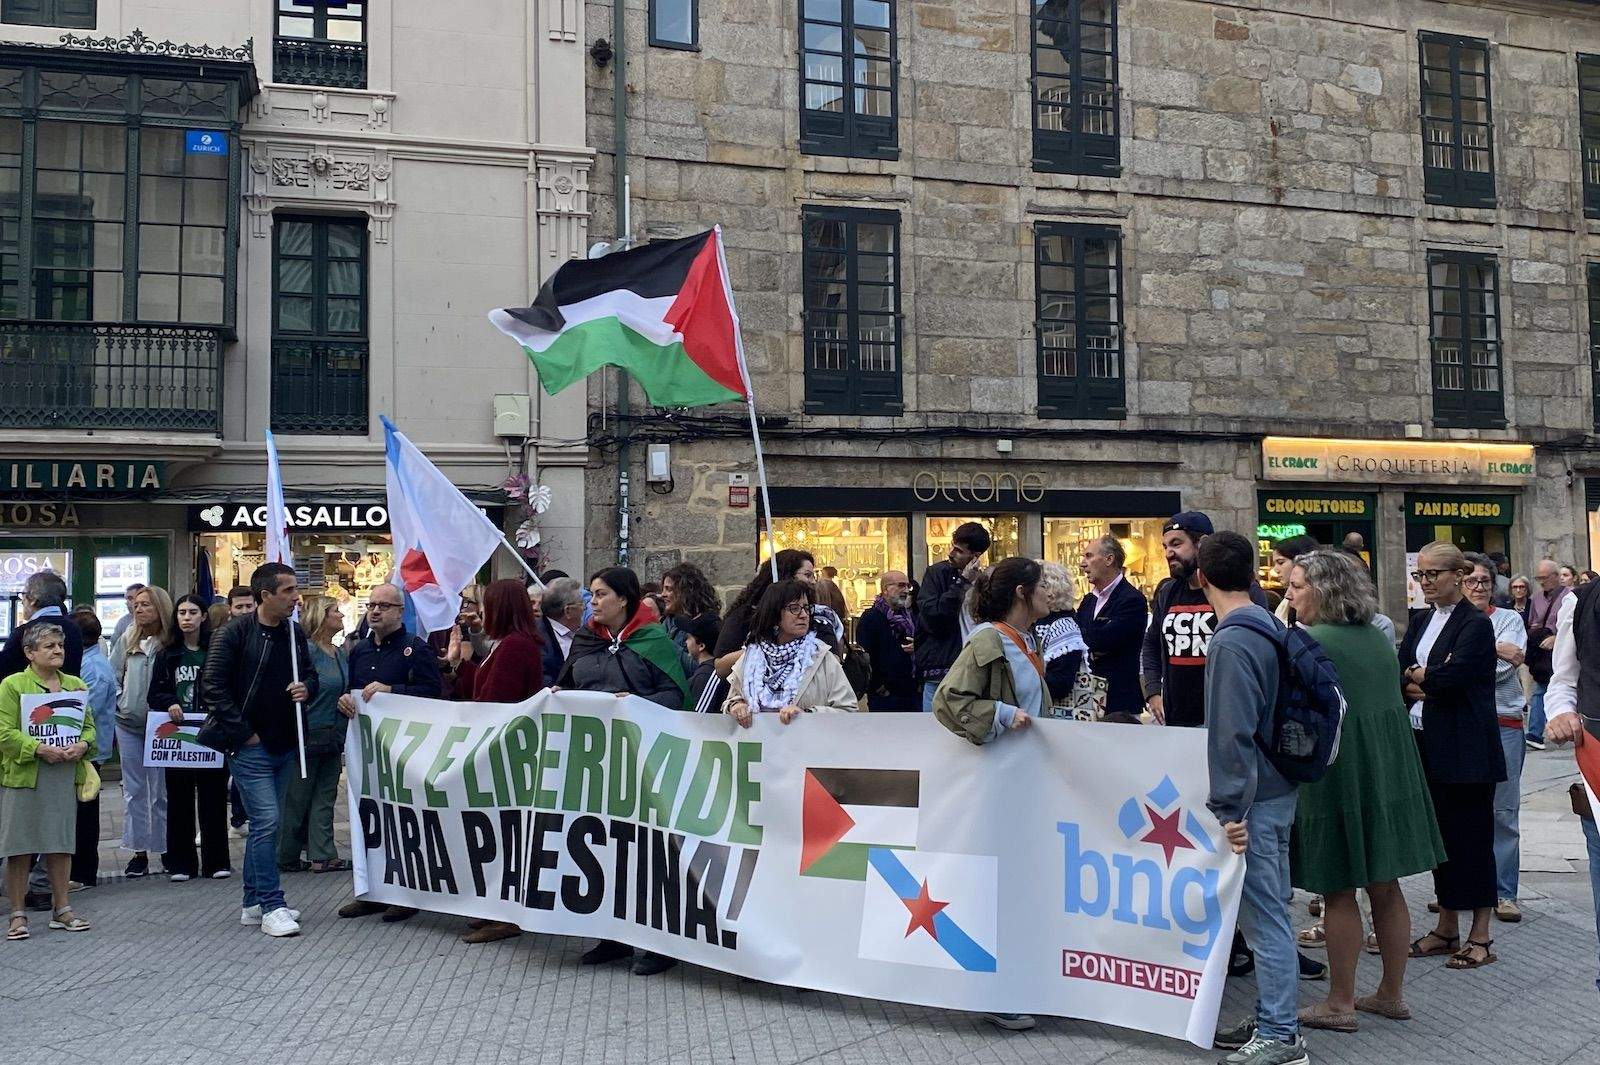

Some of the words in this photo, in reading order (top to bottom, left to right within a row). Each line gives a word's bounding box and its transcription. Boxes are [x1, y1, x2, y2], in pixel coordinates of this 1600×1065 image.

[1268, 457, 1281, 468] EL
[1282, 457, 1318, 469] CRACK
[1336, 455, 1472, 475] CROQUETERÍA
[1487, 462, 1498, 473] EL
[1500, 463, 1533, 474] CRACK
[11, 463, 160, 488] ILIARIA
[0, 502, 80, 526] OSA
[1265, 499, 1366, 515] CROQUETONES
[1414, 502, 1441, 516] PAN
[1442, 503, 1459, 516] DE
[1460, 503, 1501, 518] QUESO
[0, 556, 53, 575] OSA
[1162, 612, 1214, 634] FCK
[1165, 633, 1213, 656] SPN
[28, 724, 58, 737] GALIZA
[152, 739, 182, 750] GALIZA
[151, 750, 168, 761] CON
[171, 751, 216, 762] PALESTINA
[358, 713, 433, 805] PAZ
[424, 726, 471, 808] E
[463, 712, 764, 846] LIBERDADE
[358, 797, 459, 895] PARA
[1056, 820, 1223, 961] bng
